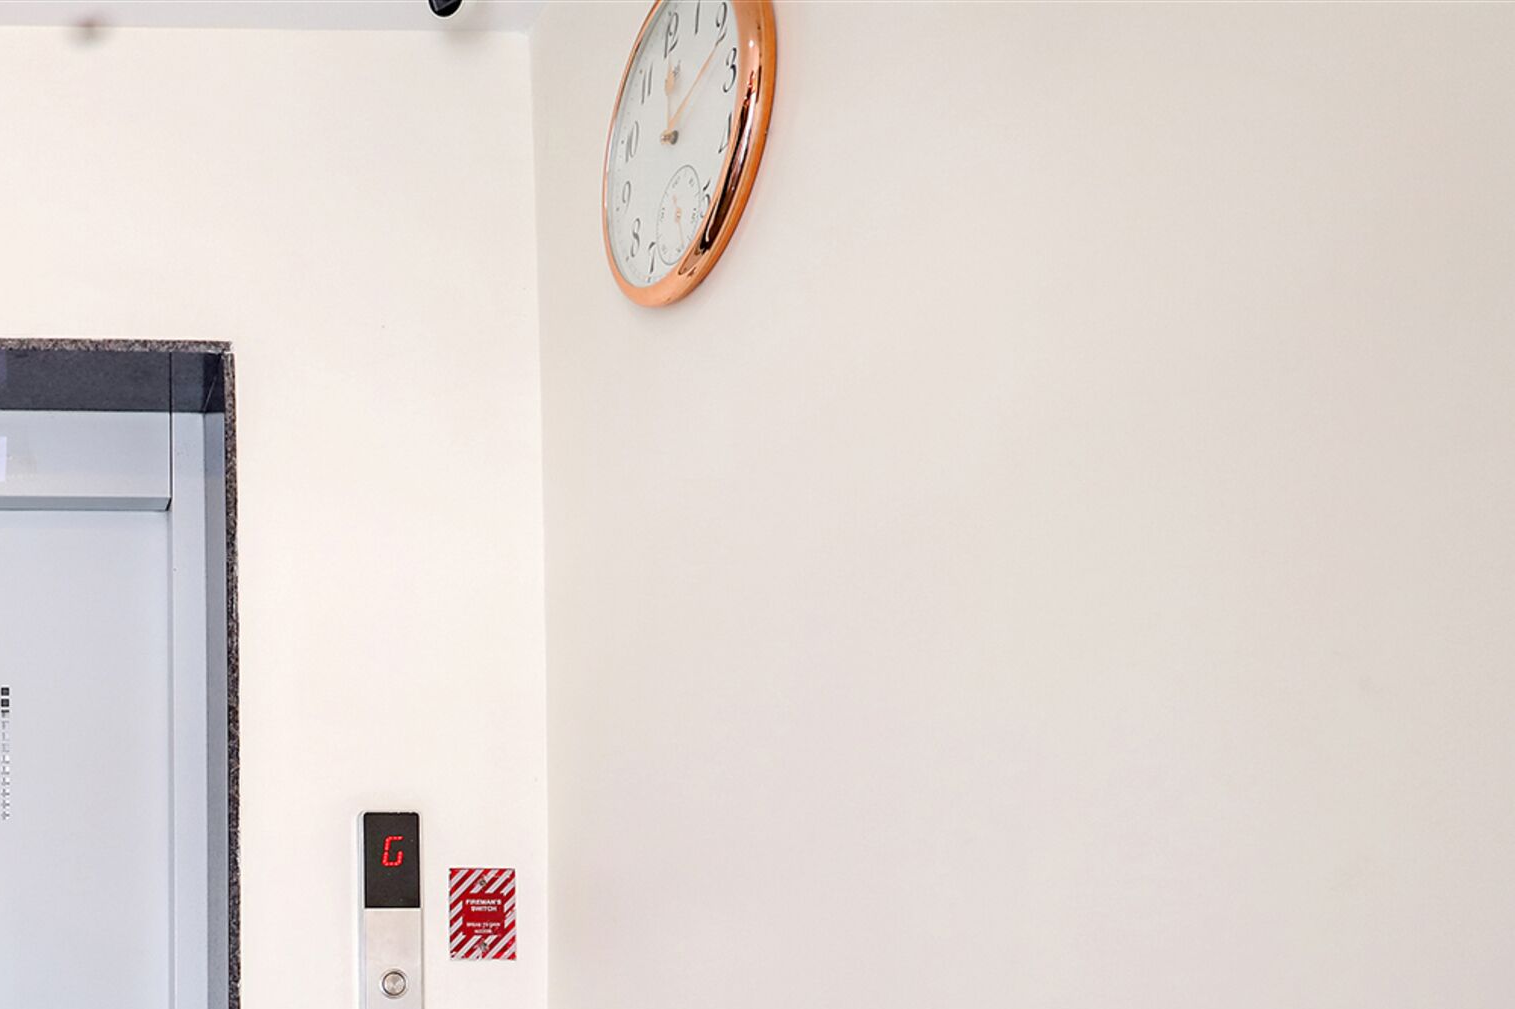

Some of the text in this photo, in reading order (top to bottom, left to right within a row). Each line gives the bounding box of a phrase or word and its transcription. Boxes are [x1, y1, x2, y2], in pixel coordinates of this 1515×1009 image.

[723, 47, 737, 93] 3
[625, 121, 640, 163] 10
[629, 218, 641, 258] 8
[381, 836, 404, 866] G
